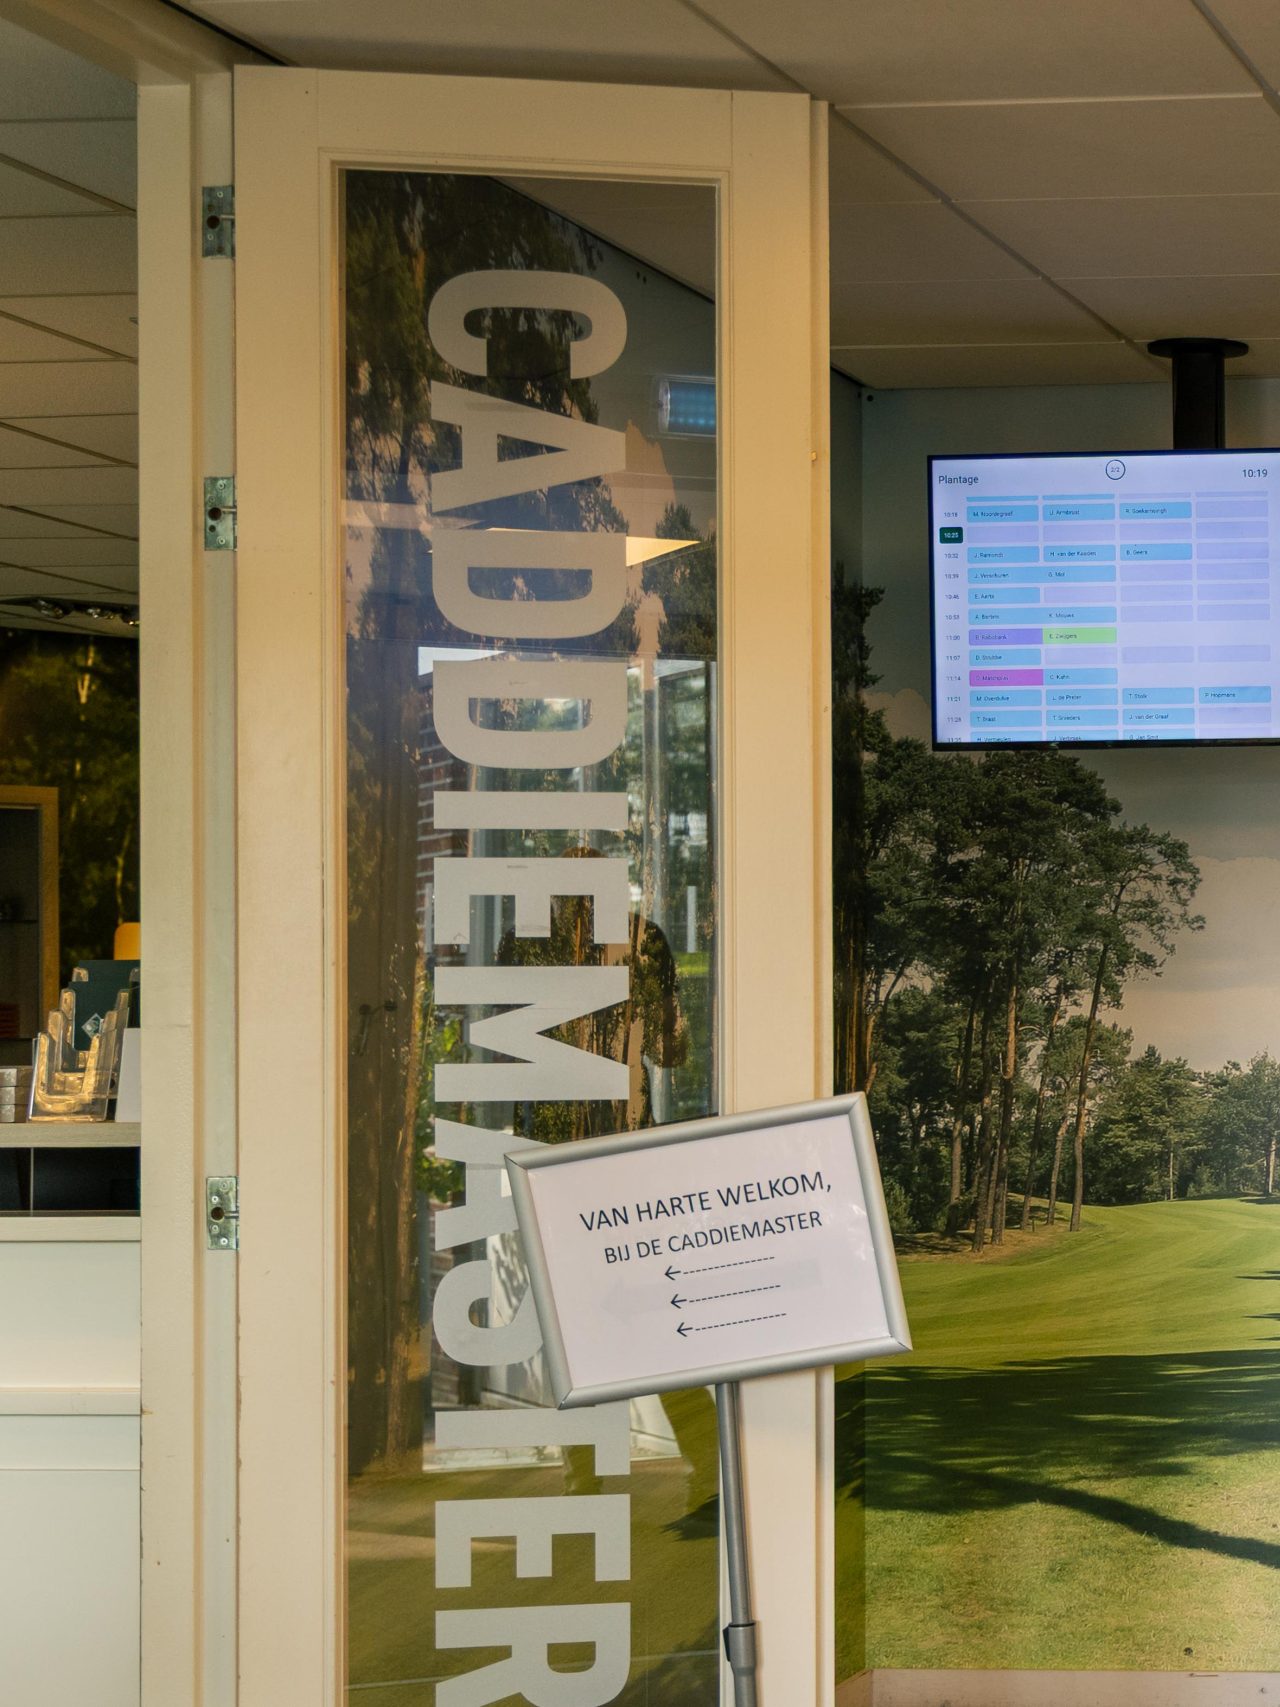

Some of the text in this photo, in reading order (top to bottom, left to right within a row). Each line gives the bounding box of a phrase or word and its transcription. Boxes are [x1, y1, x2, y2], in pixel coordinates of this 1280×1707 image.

[1242, 468, 1268, 478] 10:19
[938, 475, 979, 486] Plantage
[1145, 712, 1154, 720] der
[580, 1171, 832, 1232] VAN HARTE WELKOM,
[604, 1210, 823, 1264] BIJ DE CADDIEMASTER
